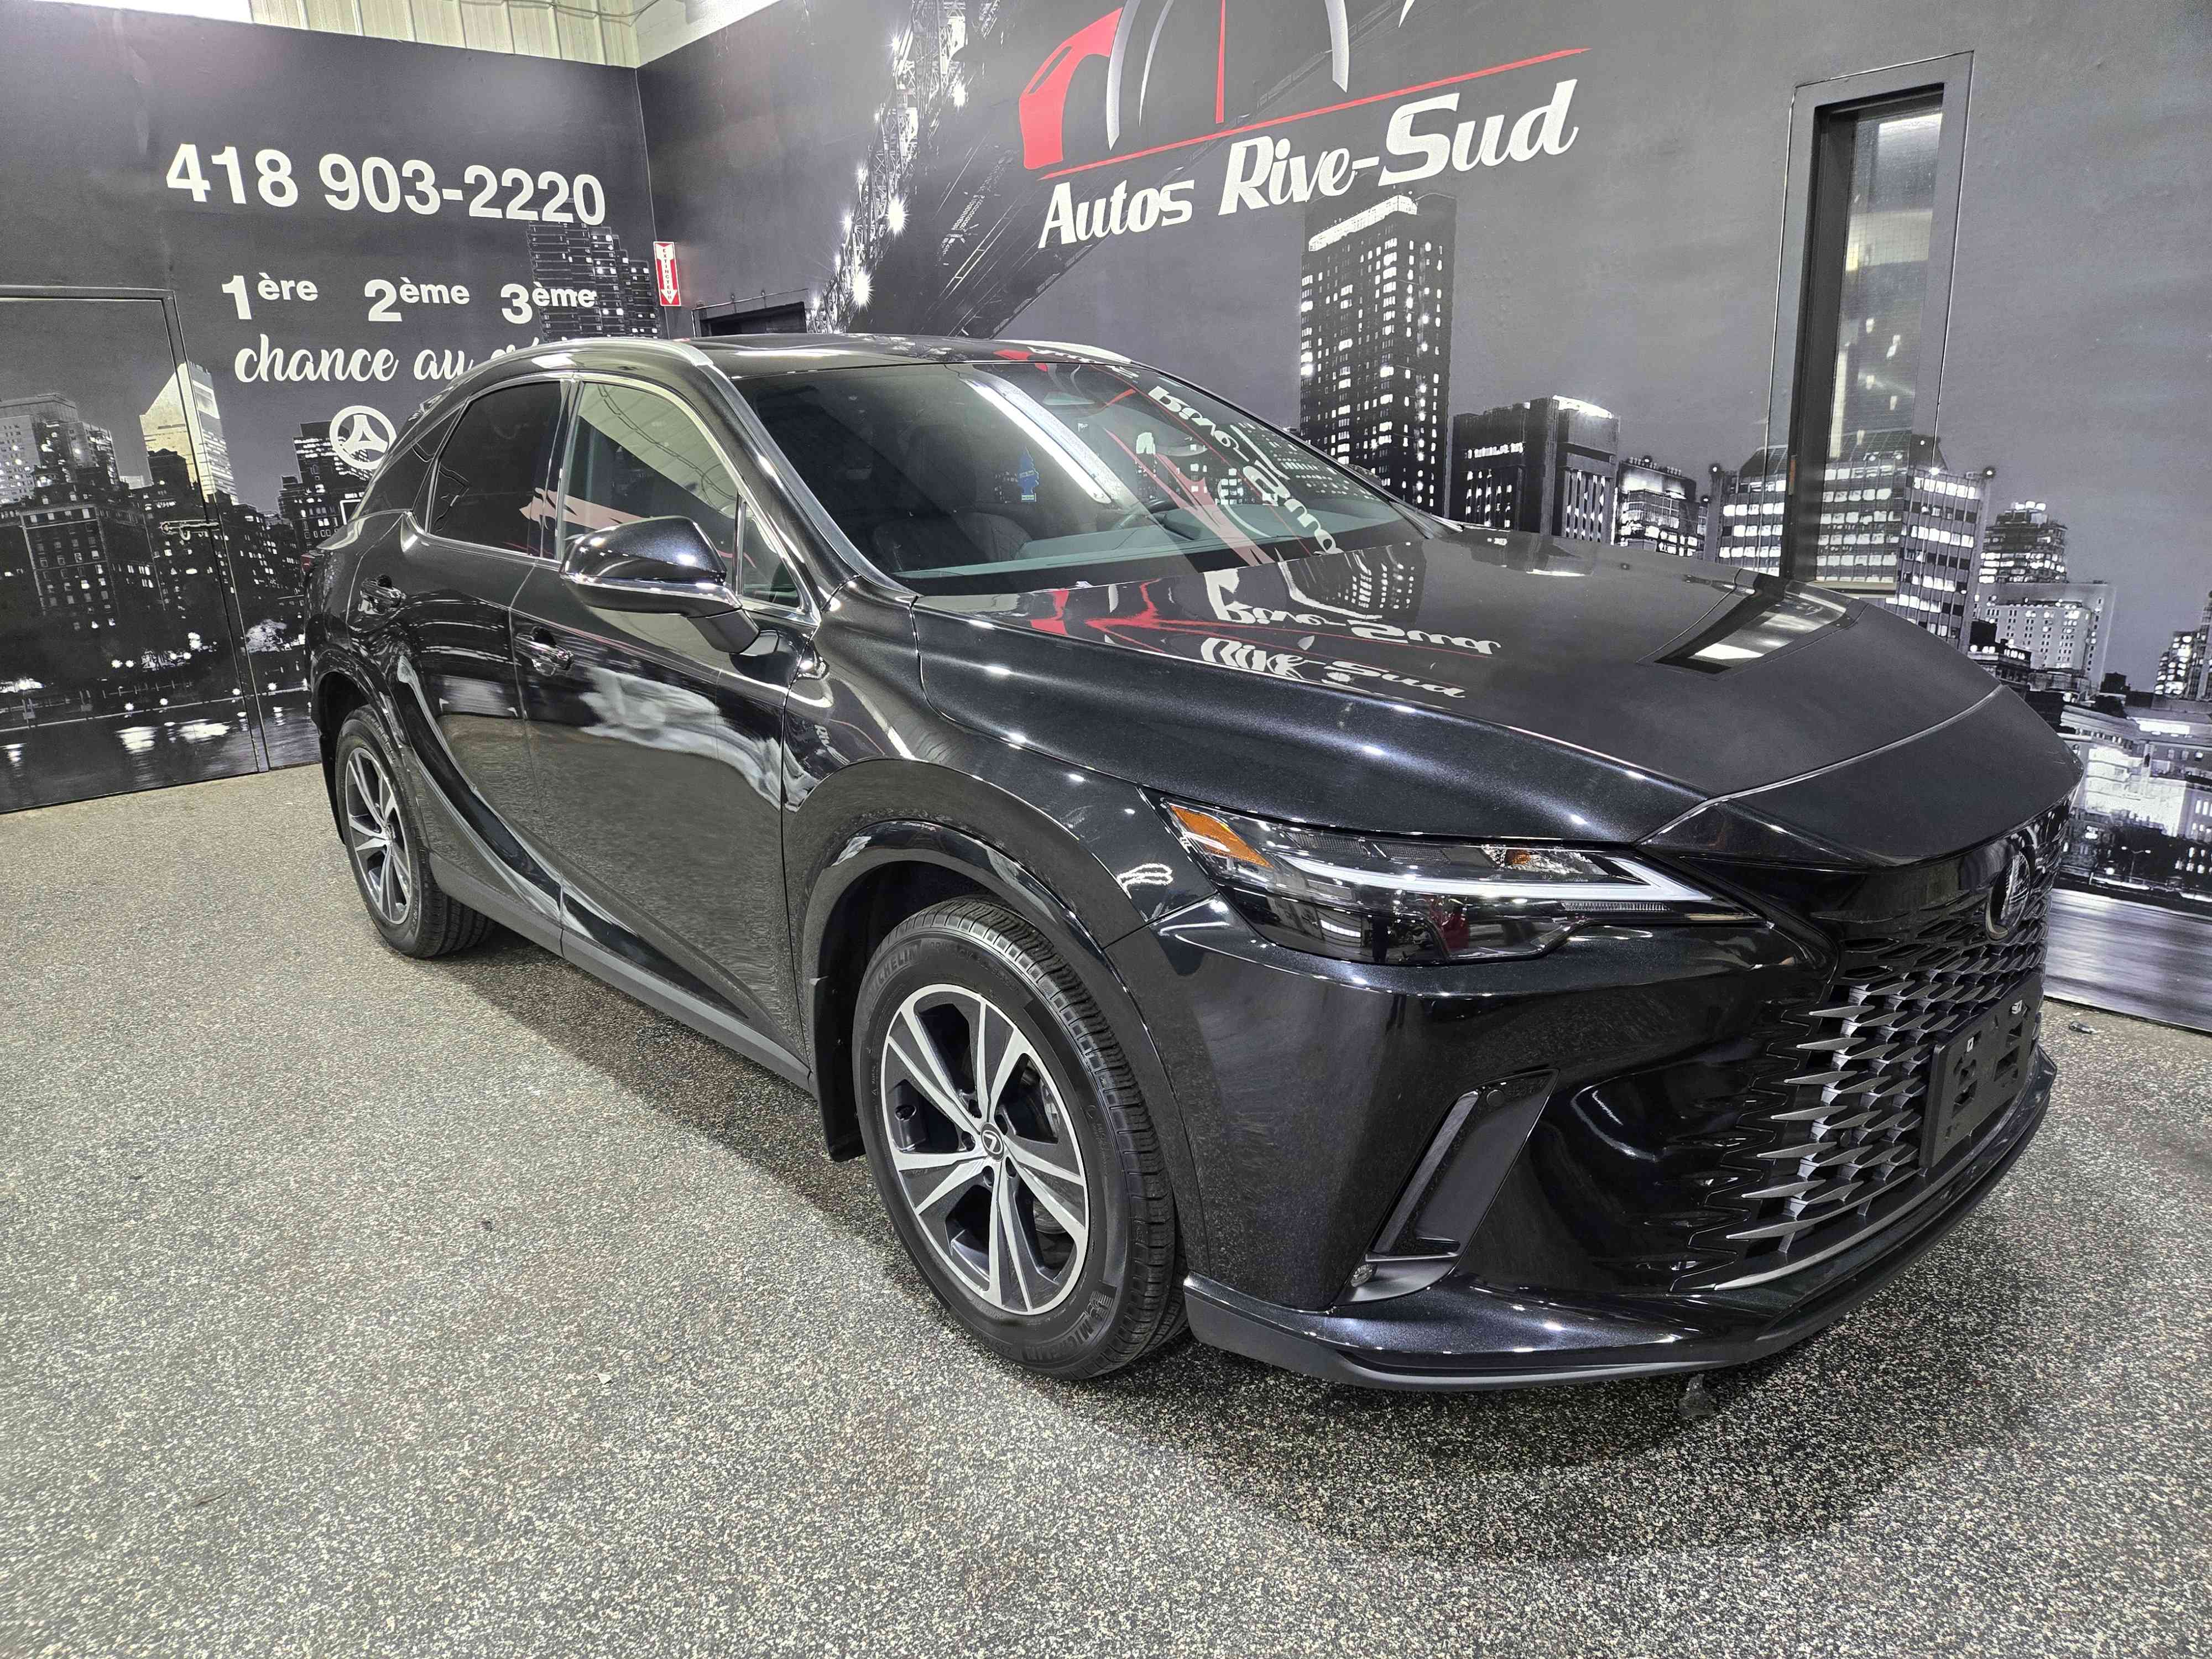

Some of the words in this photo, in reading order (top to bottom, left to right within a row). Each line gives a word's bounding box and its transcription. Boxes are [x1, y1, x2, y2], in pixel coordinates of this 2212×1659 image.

[166, 143, 299, 207] 418
[319, 153, 606, 226] 903-2220
[1037, 179, 1195, 249] Autos
[1218, 79, 1579, 216] Rive-Sud
[221, 272, 319, 320] 1ère
[364, 276, 470, 322] 2ème
[500, 281, 598, 324] 3ème
[662, 248, 672, 299] EXTINCTEUR
[234, 333, 399, 383] chance
[413, 348, 473, 380] au
